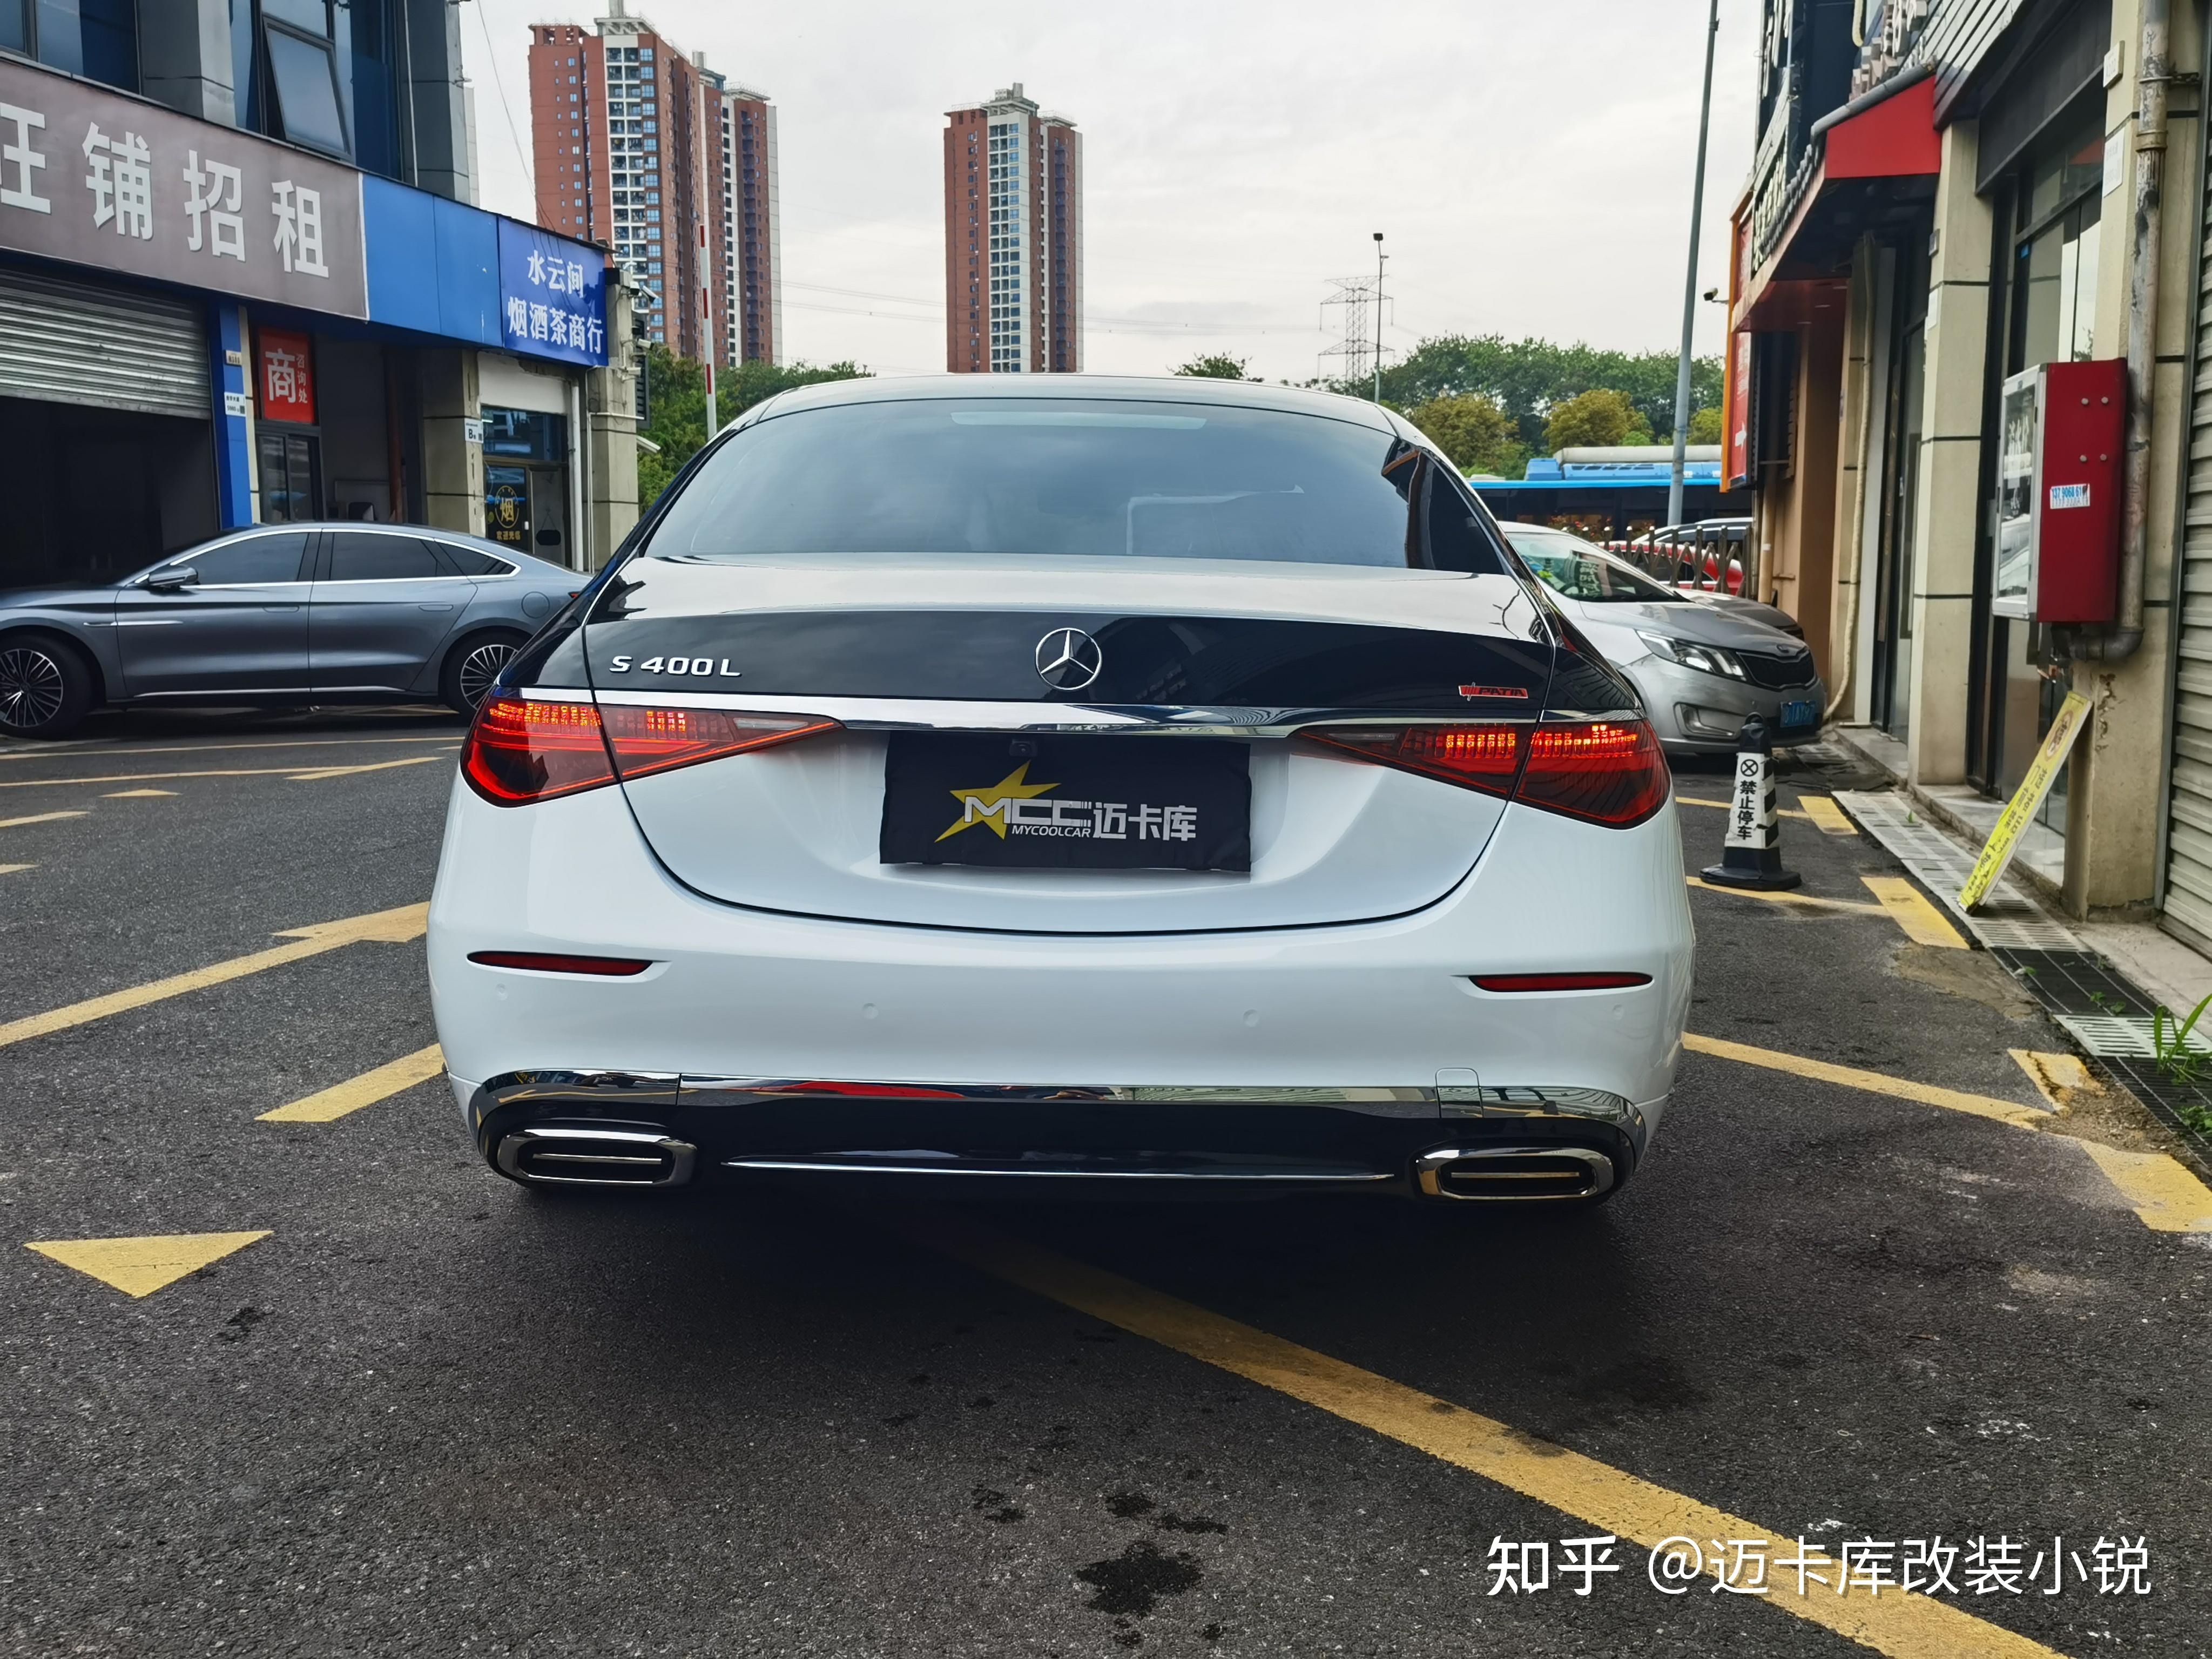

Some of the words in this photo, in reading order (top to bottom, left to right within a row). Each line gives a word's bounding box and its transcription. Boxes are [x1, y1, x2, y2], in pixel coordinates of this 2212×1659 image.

[527, 249, 583, 298] 水云间
[508, 296, 603, 354] 烟酒茶商行
[265, 348, 296, 403] 商
[500, 497, 514, 522] 烟
[609, 656, 632, 673] S
[1011, 825, 1091, 838] MYCOOLCAR
[1092, 802, 1197, 841] 迈卡库
[1737, 780, 1756, 840] 禁止停车
